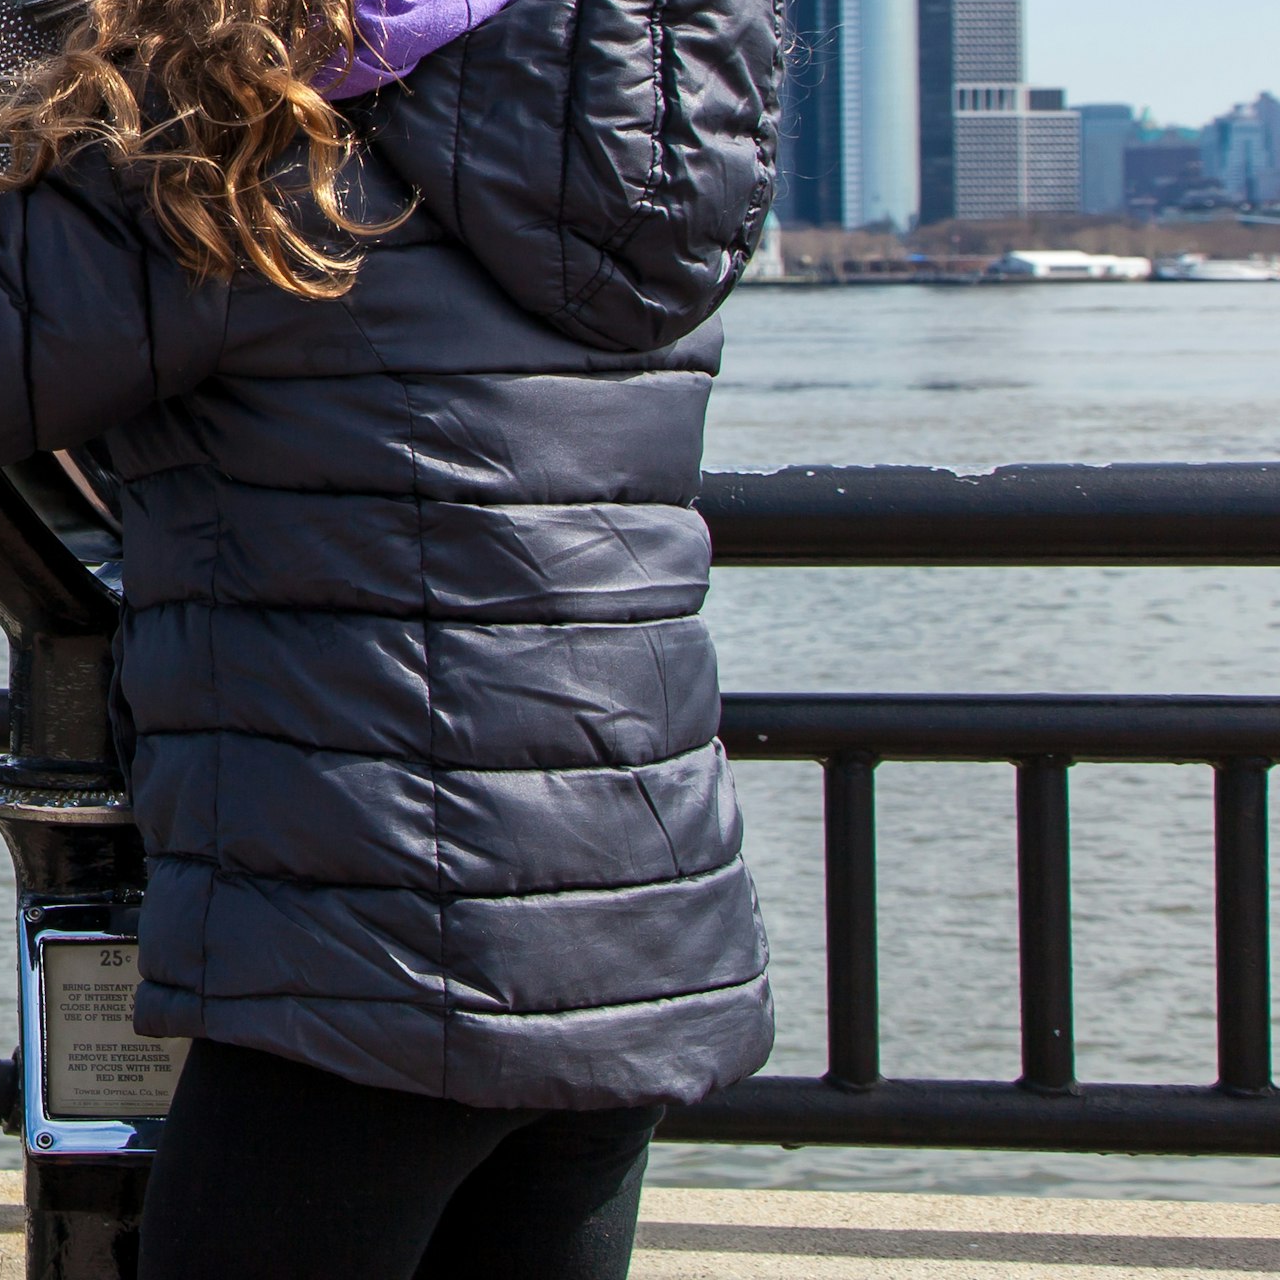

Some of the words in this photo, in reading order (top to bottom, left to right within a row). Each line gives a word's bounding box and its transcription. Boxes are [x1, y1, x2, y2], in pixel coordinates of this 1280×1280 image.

[62, 983, 91, 991] BRING
[94, 983, 133, 991] DISTANT
[68, 993, 82, 1001] OF
[84, 993, 128, 1001] INTEREST
[59, 1003, 91, 1011] CLOSE
[93, 1003, 126, 1011] RANGE
[64, 1013, 82, 1022] USE
[84, 1013, 98, 1022] OF
[101, 1013, 122, 1022] THIS
[73, 1043, 92, 1051] FOR
[95, 1043, 118, 1051] BEST
[68, 1053, 108, 1062] REMOVE
[110, 1054, 170, 1062] EYEGLASSES
[68, 1064, 88, 1072] AND
[90, 1064, 123, 1072] FOCUS
[125, 1064, 150, 1072] WITH
[153, 1064, 172, 1072] THE
[96, 1074, 114, 1082] RED
[117, 1074, 144, 1082] KNOB
